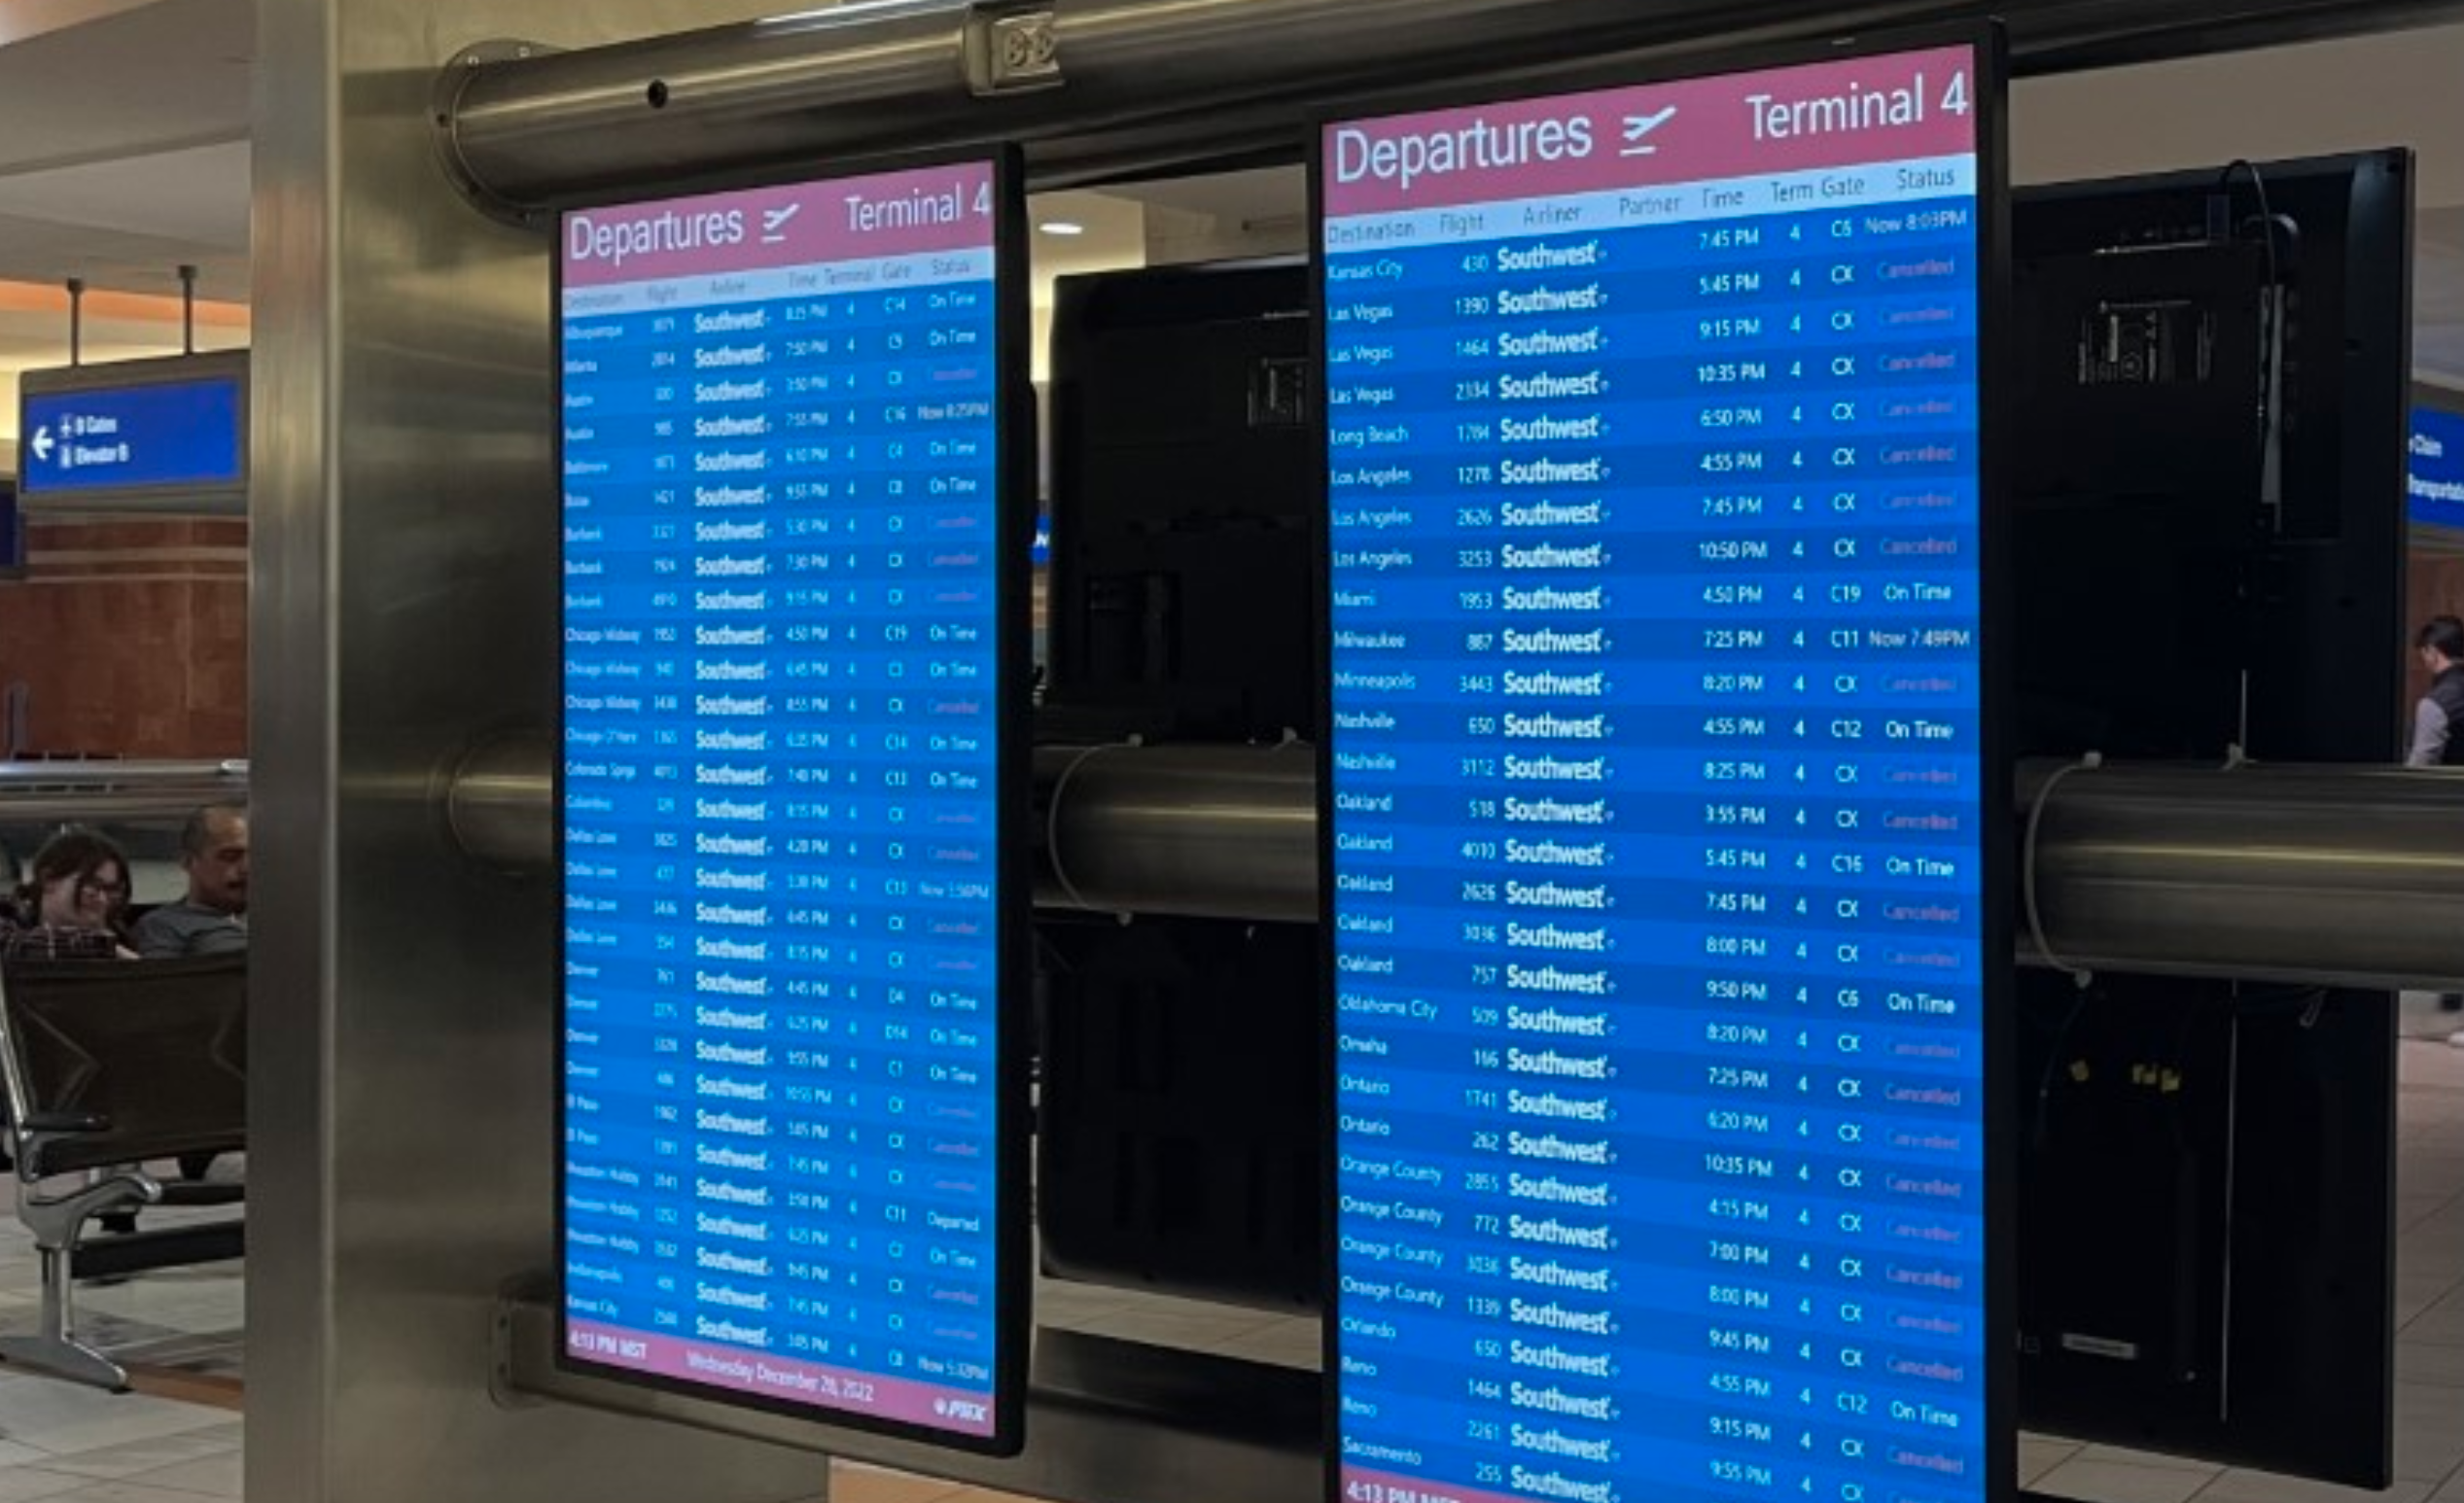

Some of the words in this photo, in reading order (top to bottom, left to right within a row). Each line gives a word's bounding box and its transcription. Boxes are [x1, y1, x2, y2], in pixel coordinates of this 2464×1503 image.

[1337, 114, 1593, 190] Departures
[1746, 74, 1924, 141] Terminal
[1941, 72, 1969, 115] 4
[1440, 214, 1484, 237] Flight
[1524, 205, 1583, 226] Airliner
[1620, 192, 1682, 218] Partner
[1703, 189, 1743, 208] Time
[1772, 182, 1813, 203] Term
[1821, 176, 1864, 196] Gate
[1896, 163, 1954, 190] Status
[571, 211, 744, 266] Departures
[844, 183, 962, 231] Terminal
[972, 182, 991, 216] 4
[1327, 264, 1373, 281] Kansas
[1377, 260, 1402, 279] City
[1497, 239, 1601, 272] Southwest
[694, 309, 764, 332] Southwest
[1328, 307, 1350, 321] Las
[1354, 302, 1392, 322] Vegas
[1329, 347, 1351, 363] Las
[1354, 344, 1393, 365] Vegas
[1498, 326, 1601, 357] Southwest
[1700, 319, 1730, 338] 9:15
[1330, 388, 1351, 404] Las
[1354, 386, 1394, 405] Vegas
[1698, 363, 1736, 382] 10:35
[1741, 362, 1765, 380] PM
[1330, 429, 1364, 447] Long
[1368, 425, 1408, 442] Beach
[1500, 412, 1602, 441] Southwest
[1701, 408, 1733, 426] 6:50
[694, 448, 764, 472] Southwest
[1330, 470, 1354, 484] Los
[1357, 467, 1411, 486] Angeles
[1331, 509, 1355, 526] Los
[1358, 507, 1412, 529] Angeles
[1501, 498, 1602, 526] Southwest
[1704, 497, 1733, 515] 7:45
[1333, 550, 1355, 567] Los
[1359, 549, 1412, 571] Angeles
[1700, 542, 1737, 559] 10:50
[1502, 584, 1602, 611] Southwest
[1704, 584, 1734, 603] 4:50
[1831, 584, 1861, 603] C19
[1884, 584, 1909, 601] On
[1914, 583, 1953, 601] Time
[695, 624, 764, 644] Southwest
[1831, 629, 1858, 647] C11
[1503, 711, 1604, 738] Southwest
[1704, 717, 1736, 735] 4:55
[1831, 718, 1861, 738] C12
[1885, 720, 1909, 738] On
[1916, 720, 1954, 740] Time
[1740, 761, 1765, 778] PM
[696, 797, 764, 821] Southwest
[1335, 791, 1391, 811] Oakland
[1336, 832, 1392, 851] Oakland
[1504, 838, 1605, 866] Southwest
[1707, 848, 1736, 866] 5:45
[1886, 856, 1910, 874] On
[1916, 857, 1954, 876] Time
[1337, 874, 1393, 891] Oakland
[1707, 891, 1737, 911] 7:45
[1337, 912, 1393, 933] Oakland
[1707, 935, 1737, 954] 8:00
[696, 970, 764, 996] Southwest
[1337, 954, 1393, 973] Oakland
[1506, 962, 1607, 994] Southwest
[1707, 979, 1737, 997] 9:50
[1887, 993, 1912, 1011] On
[1917, 994, 1955, 1014] Time
[1337, 993, 1406, 1015] Oklahoma
[1411, 998, 1437, 1019] City
[1339, 1072, 1390, 1094] Ontario
[1507, 1088, 1607, 1122] Southwest
[1340, 1114, 1390, 1136] Ontario
[1706, 1153, 1743, 1173] 10:35
[1340, 1154, 1390, 1179] Orange
[1392, 1161, 1441, 1186] County
[1709, 1198, 1740, 1217] 4:15
[1340, 1194, 1390, 1219] Orange
[1393, 1201, 1442, 1227] County
[1508, 1213, 1609, 1249] Southwest
[1709, 1240, 1740, 1261] 7:00
[1340, 1234, 1390, 1260] Orange
[1394, 1242, 1443, 1267] County
[1709, 1284, 1740, 1305] 8:00
[1744, 1288, 1769, 1308] PM
[696, 1314, 764, 1345] Southwest
[1341, 1275, 1391, 1300] Orange
[1395, 1281, 1444, 1308] County
[1709, 1328, 1741, 1348] 9:45
[686, 1350, 755, 1382] Wednesday
[757, 1363, 822, 1390] December
[1341, 1315, 1396, 1338] Orlando
[1510, 1339, 1610, 1378] Southwest
[1709, 1373, 1741, 1392] 4:55
[1837, 1391, 1867, 1414] C12
[1890, 1399, 1915, 1418] On
[1920, 1404, 1958, 1427] Time
[1510, 1422, 1610, 1462] Southwest
[1709, 1416, 1742, 1436] 9:15
[1342, 1435, 1422, 1465] Sacramento
[1347, 1481, 1384, 1503] 4:13
